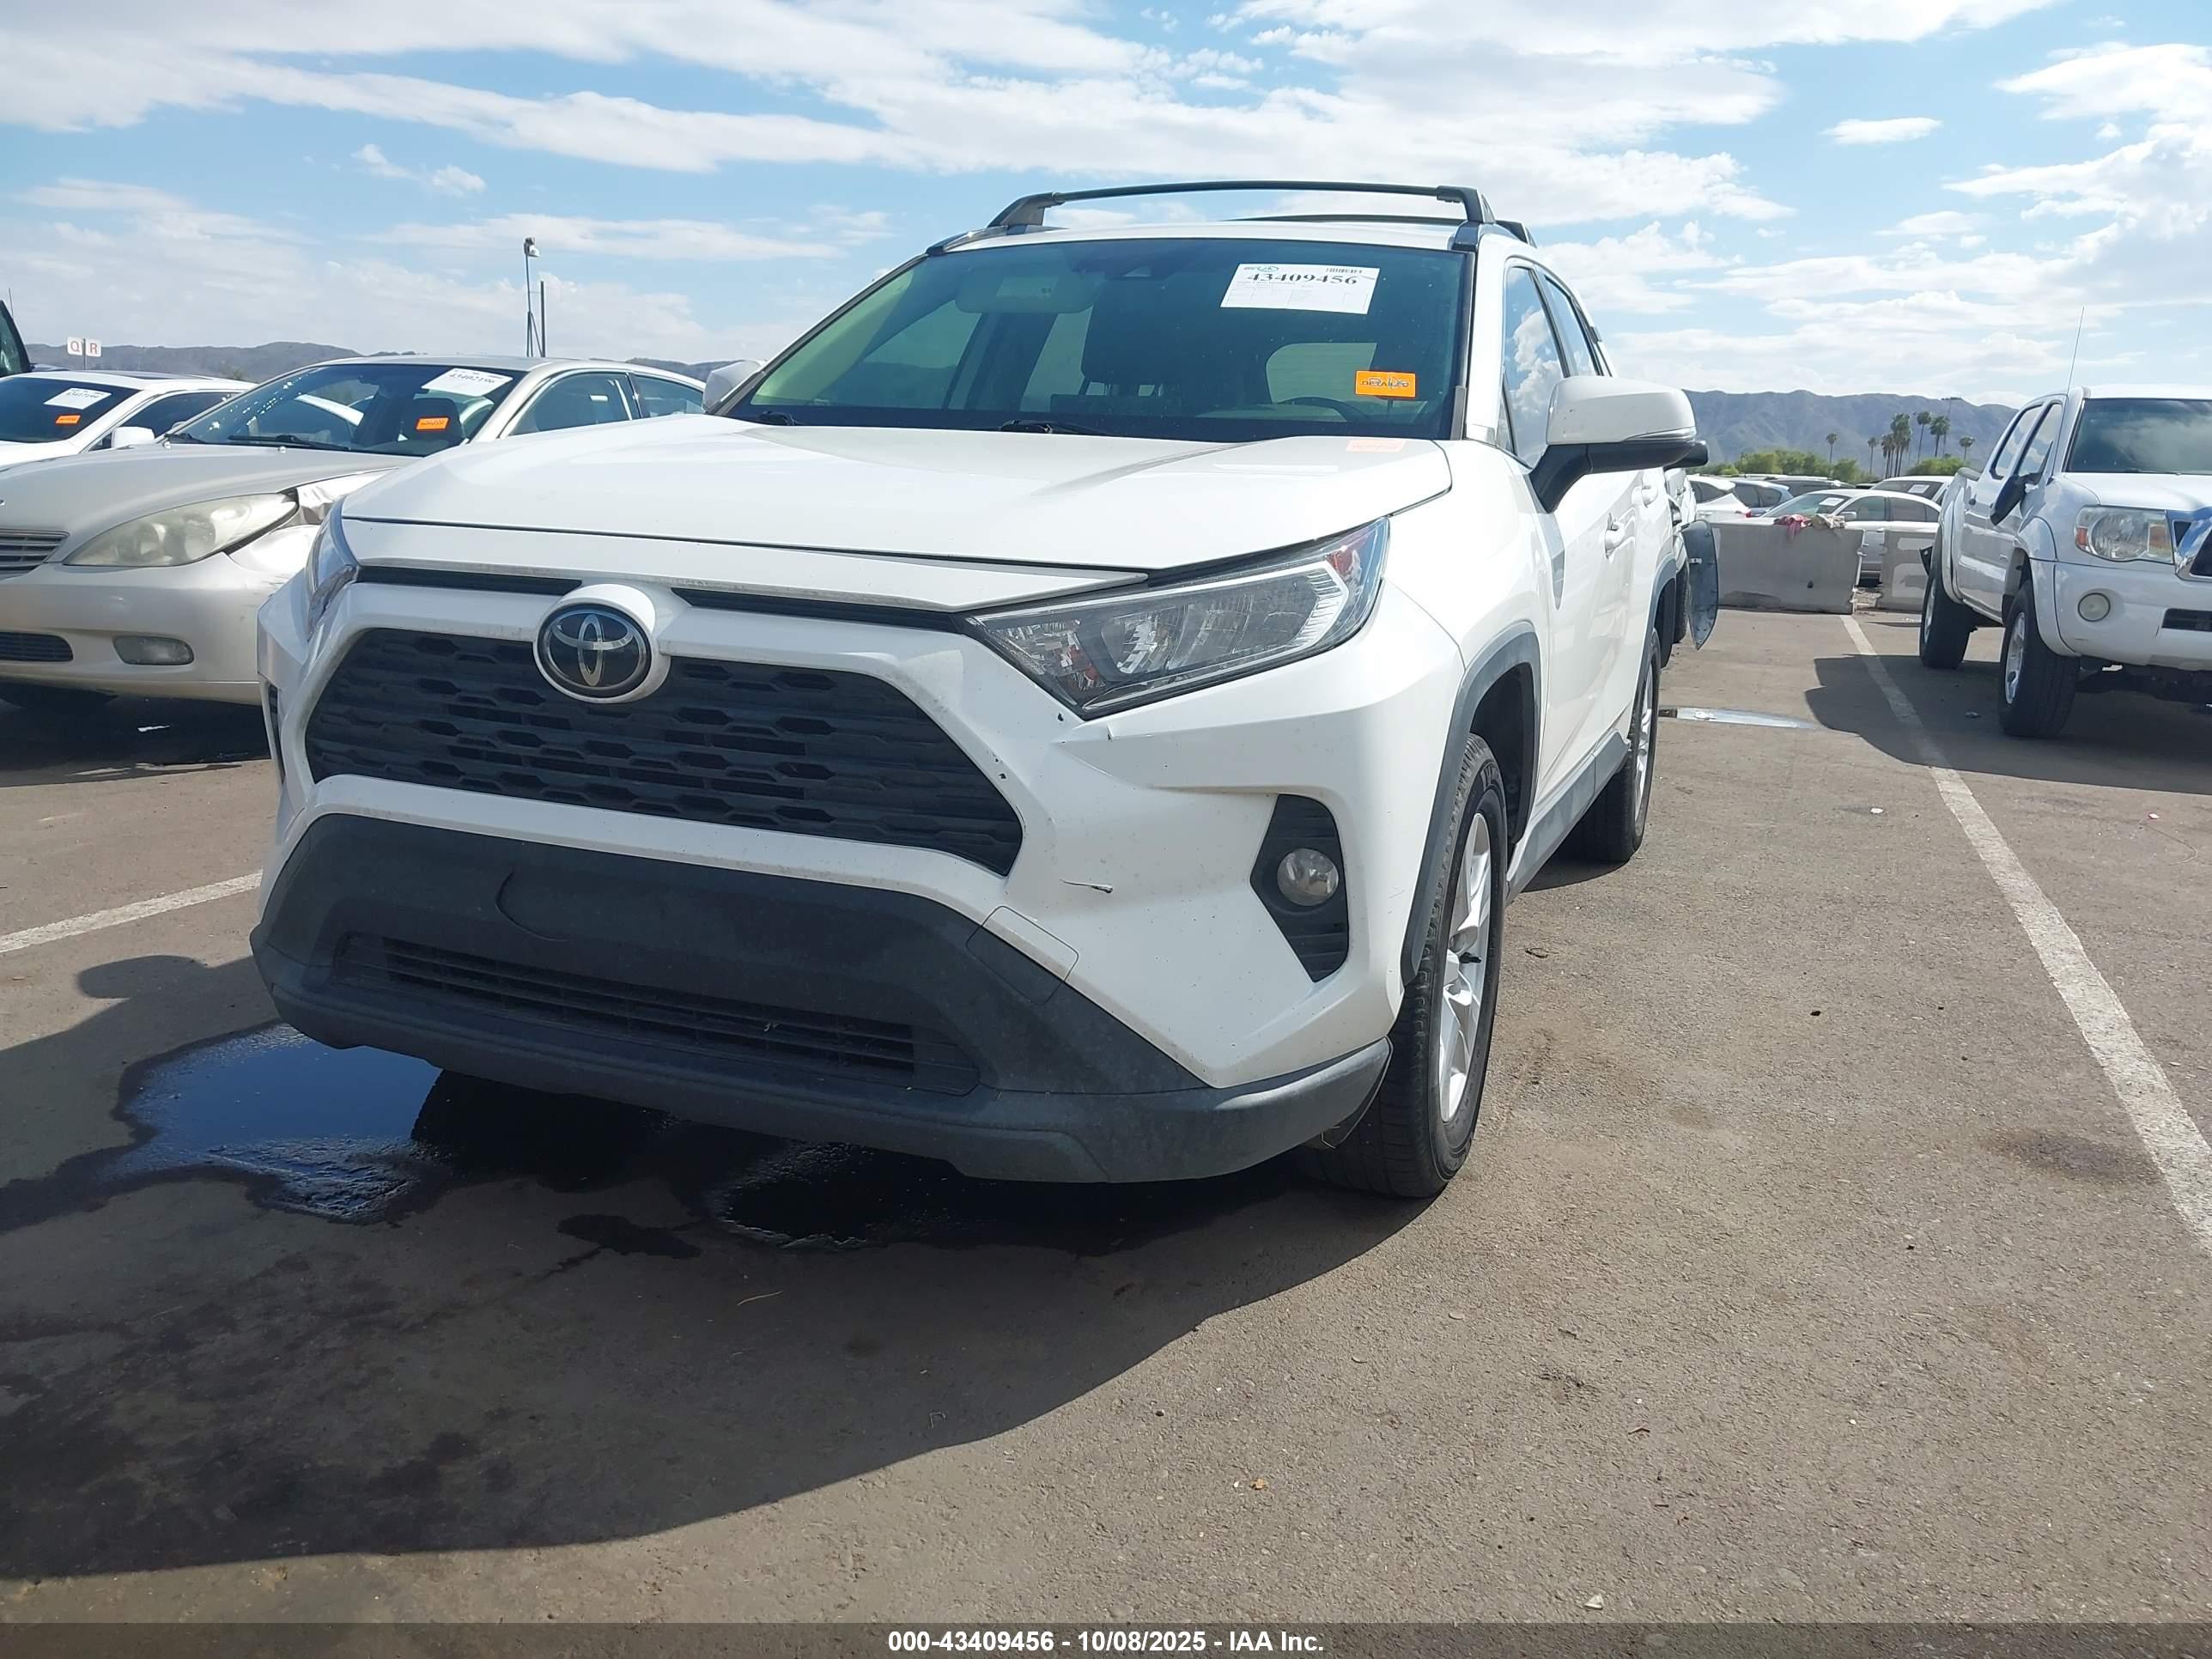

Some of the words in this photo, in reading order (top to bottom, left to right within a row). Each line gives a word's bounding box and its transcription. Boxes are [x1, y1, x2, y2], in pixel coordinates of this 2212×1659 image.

[1247, 272, 1358, 285] 43409456
[70, 340, 81, 352] Q
[89, 343, 98, 355] R
